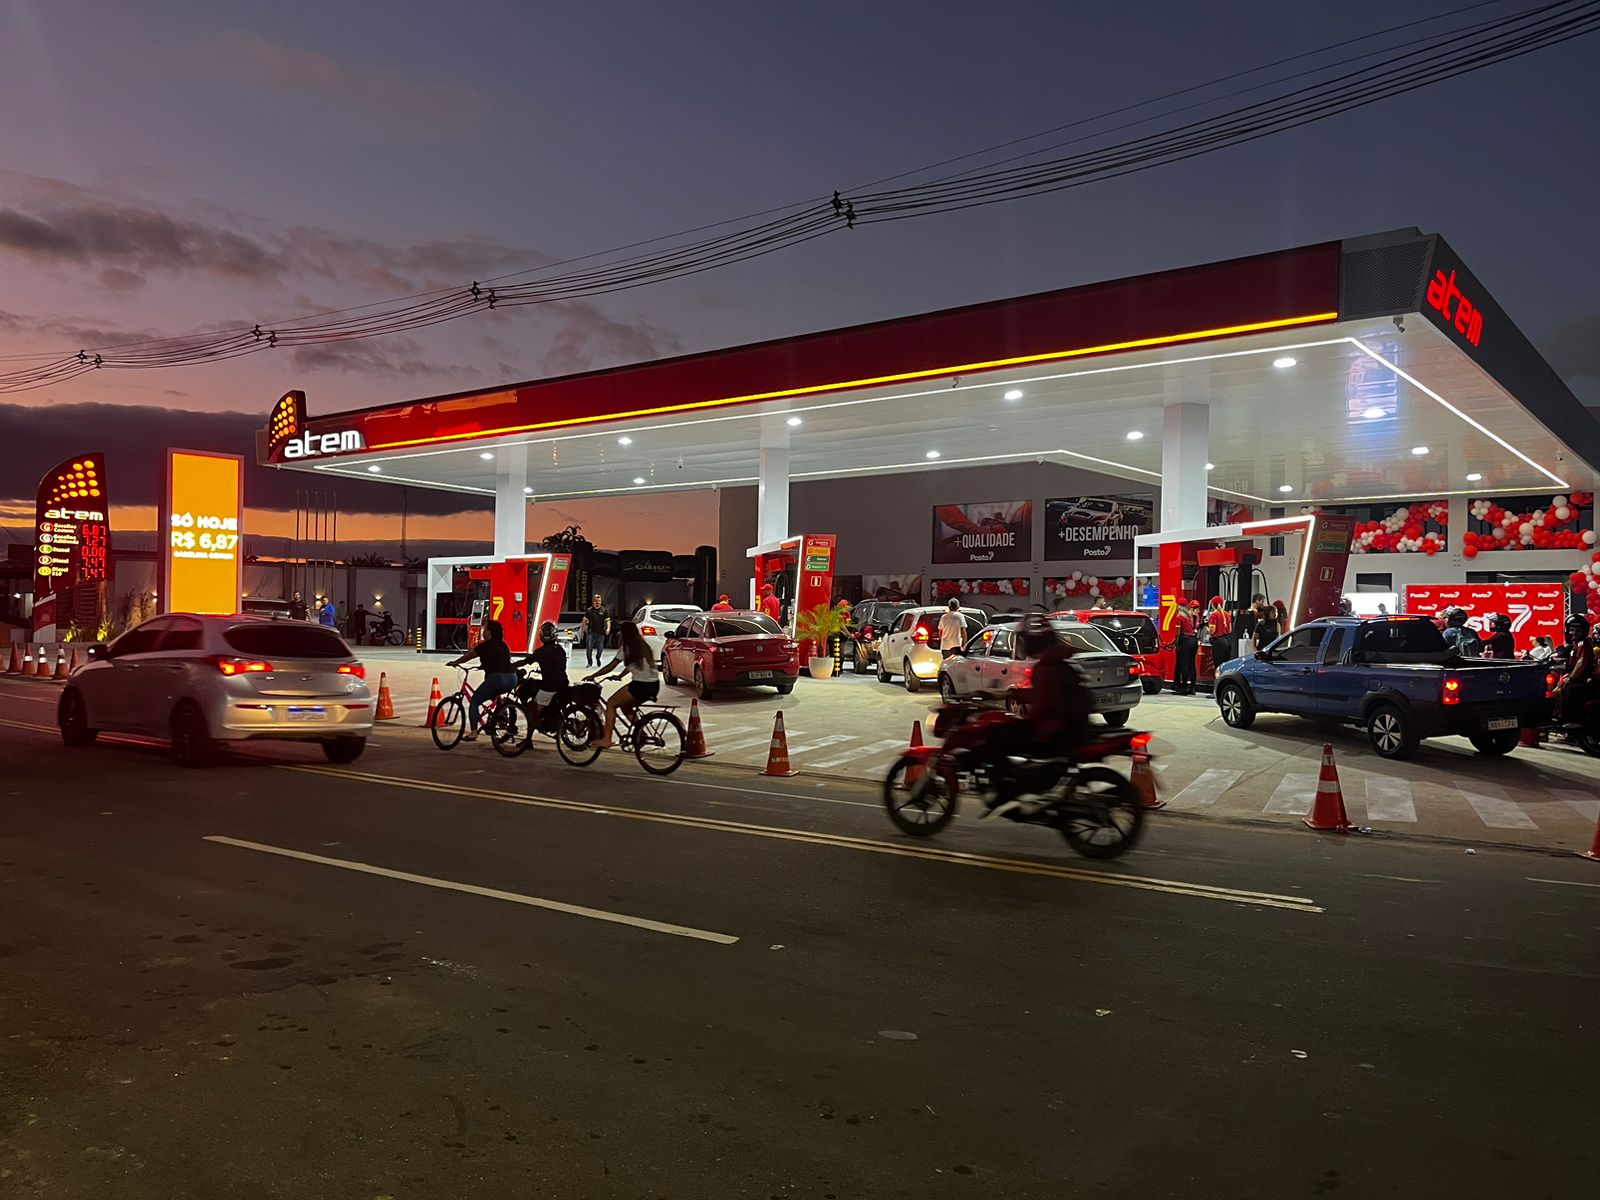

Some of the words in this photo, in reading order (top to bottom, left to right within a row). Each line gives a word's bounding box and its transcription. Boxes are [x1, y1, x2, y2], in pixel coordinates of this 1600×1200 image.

[1427, 269, 1484, 349] atem
[284, 430, 361, 458] atem
[44, 507, 104, 521] atem
[196, 515, 238, 531] HOJE
[171, 531, 196, 549] R$
[199, 532, 239, 551] 6,87
[1162, 595, 1177, 631] 7
